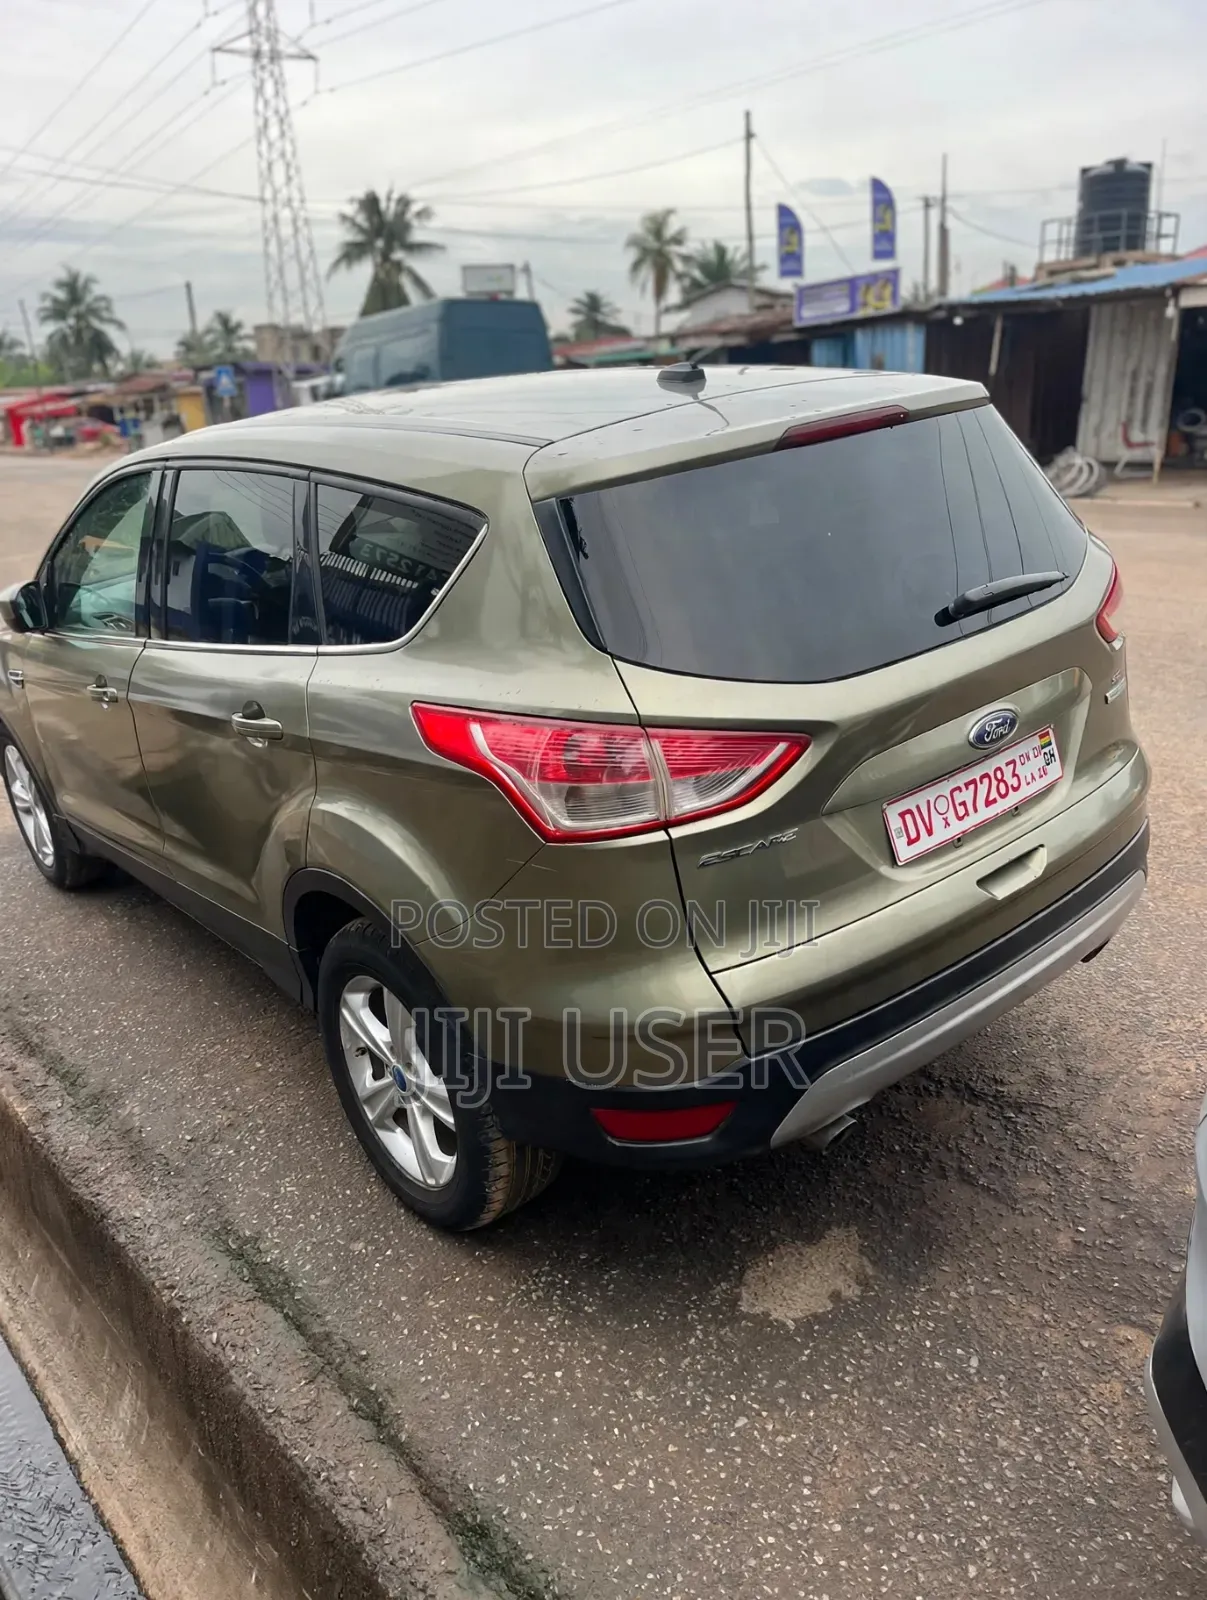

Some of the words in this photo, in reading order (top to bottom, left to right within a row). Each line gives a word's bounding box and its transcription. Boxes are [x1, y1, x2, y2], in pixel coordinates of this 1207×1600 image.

[984, 717, 1011, 743] Ford
[1043, 747, 1057, 766] GH
[897, 799, 934, 846] DV
[949, 757, 1022, 822] G7283
